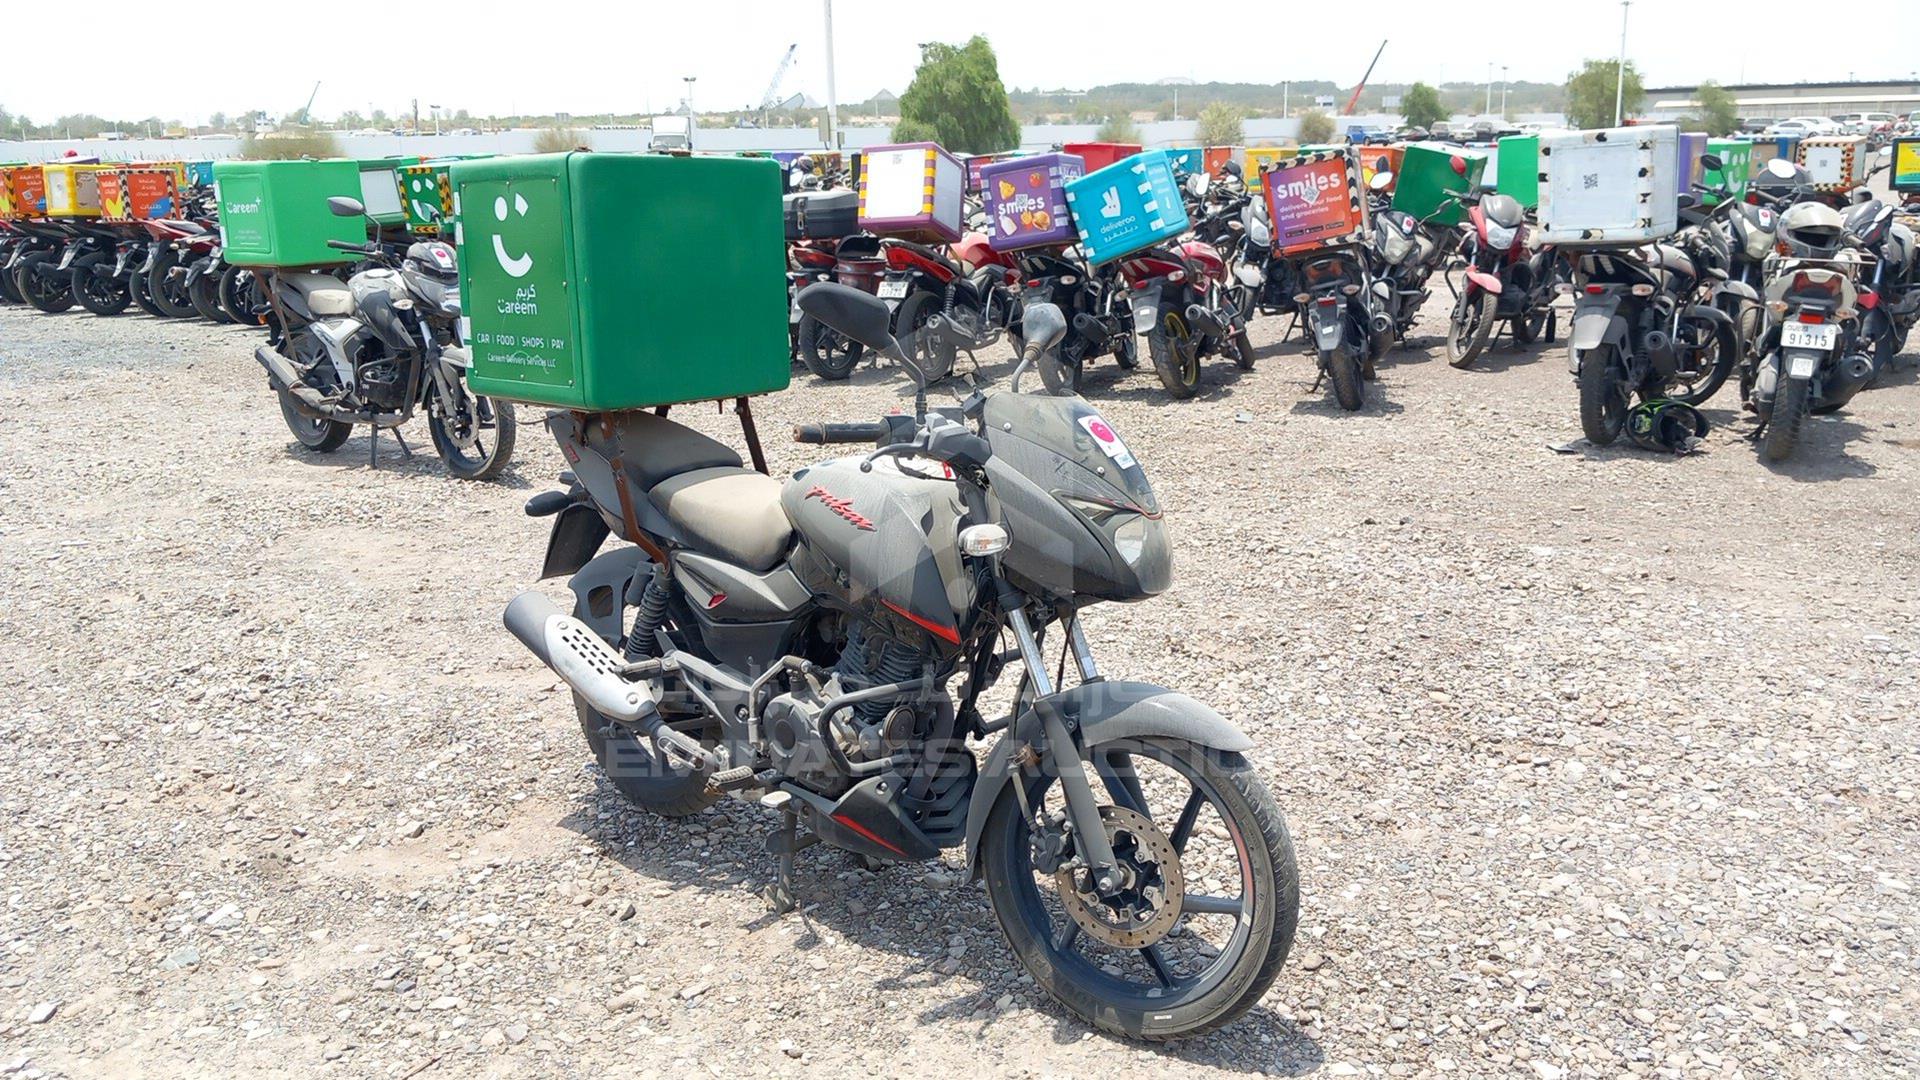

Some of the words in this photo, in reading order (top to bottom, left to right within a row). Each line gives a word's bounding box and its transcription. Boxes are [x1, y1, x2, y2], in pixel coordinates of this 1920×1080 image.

[998, 196, 1045, 215] smes
[1101, 215, 1136, 233] deliveroo
[516, 284, 536, 302] كريم
[497, 299, 538, 315] Careem
[476, 333, 490, 344] CAR
[496, 334, 515, 346] FOOD
[521, 336, 545, 349] SHOPS
[551, 339, 564, 349] PAY
[1789, 333, 1828, 347] 91315
[487, 352, 506, 362] Careem
[547, 358, 556, 368] LLC
